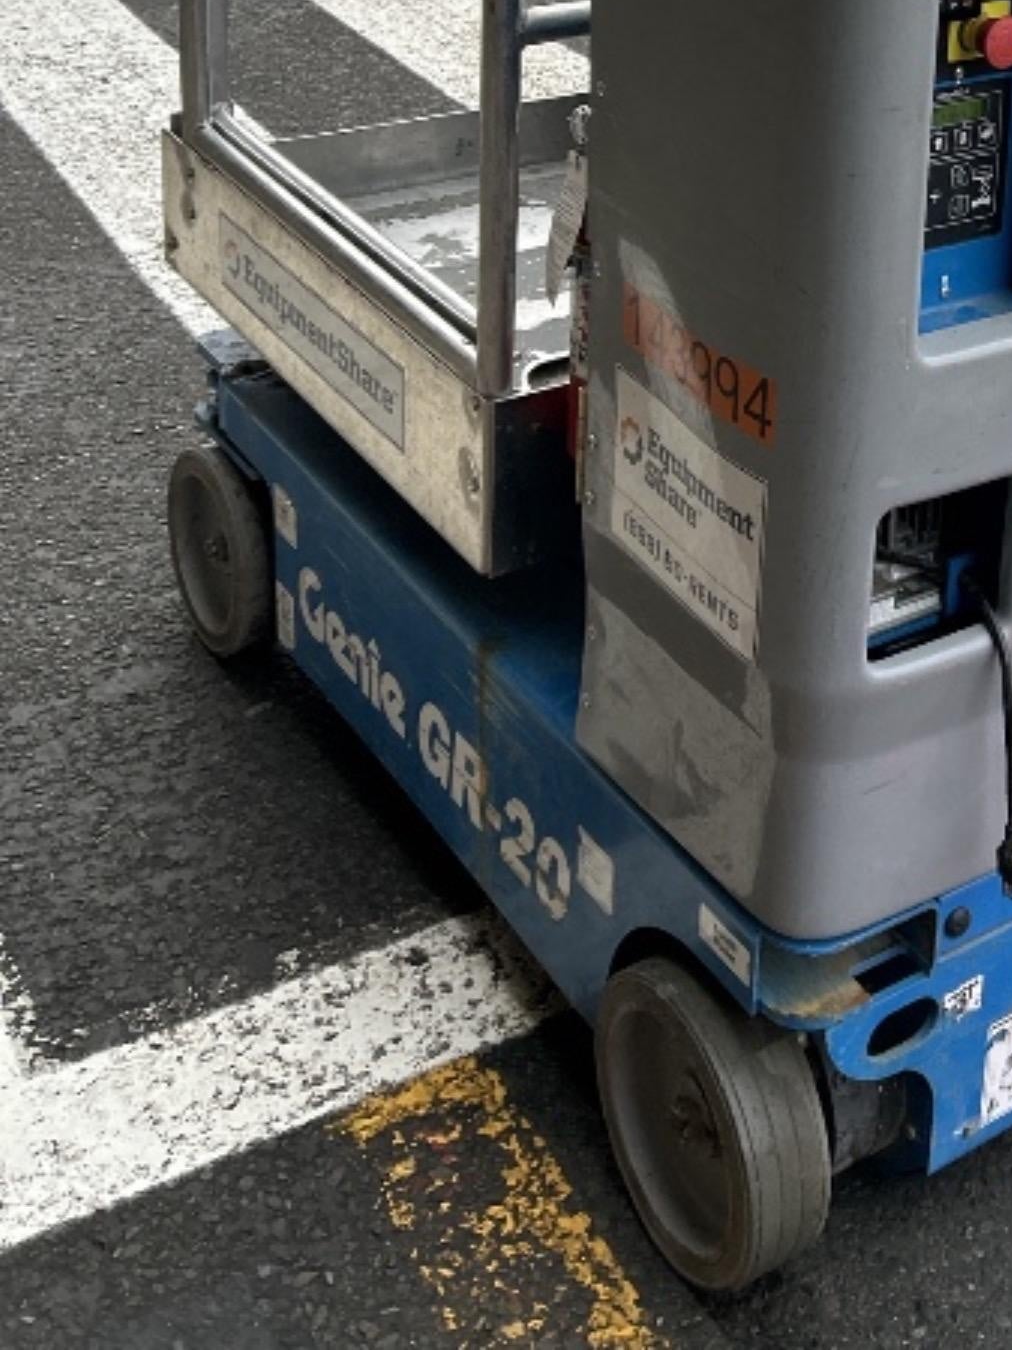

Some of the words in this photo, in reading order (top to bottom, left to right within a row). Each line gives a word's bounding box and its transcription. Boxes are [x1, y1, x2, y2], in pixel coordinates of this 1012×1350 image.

[644, 458, 697, 529] Share
[647, 426, 754, 542] Equipment
[300, 566, 406, 738] Genie
[418, 701, 571, 922] GR-20
